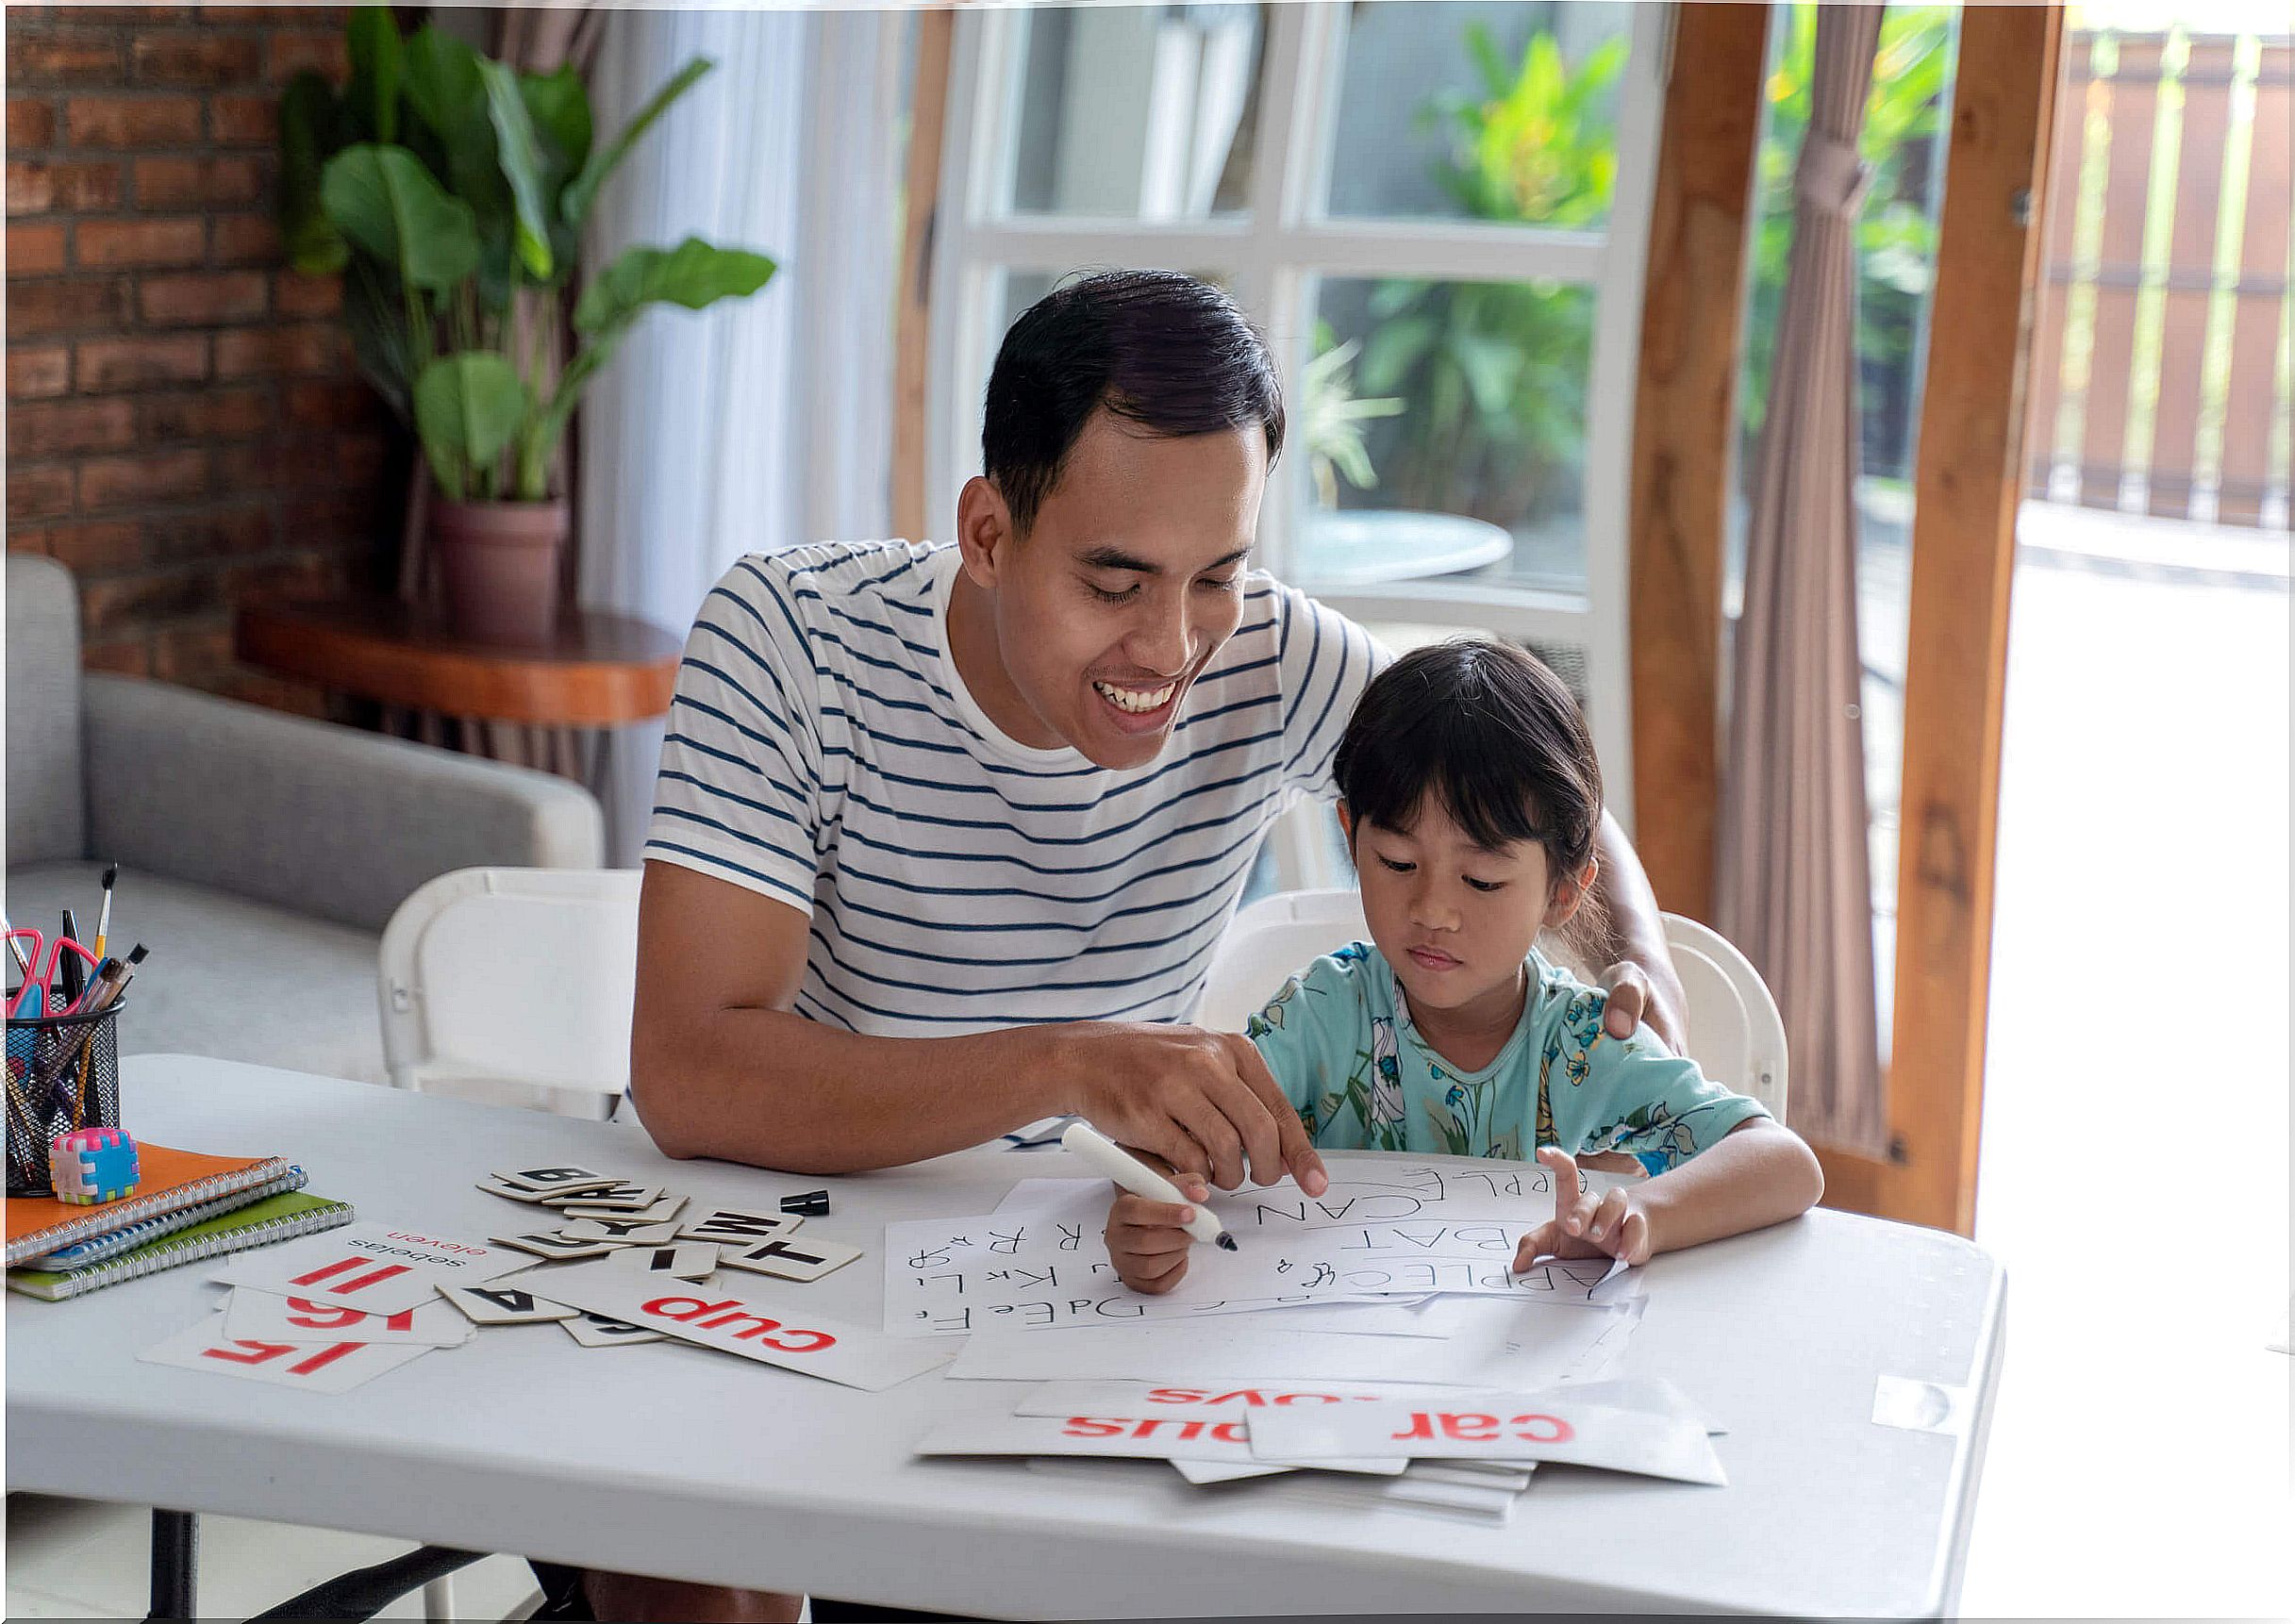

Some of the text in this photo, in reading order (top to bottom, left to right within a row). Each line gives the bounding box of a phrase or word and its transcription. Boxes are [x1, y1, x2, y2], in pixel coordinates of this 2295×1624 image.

[1257, 1194, 1422, 1224] CAN
[348, 1237, 466, 1268] sebelas
[388, 1231, 488, 1257] eleven
[1339, 1227, 1510, 1251] BAT
[288, 1256, 415, 1296] 11
[640, 1297, 838, 1353] cup
[1390, 1411, 1576, 1443] car
